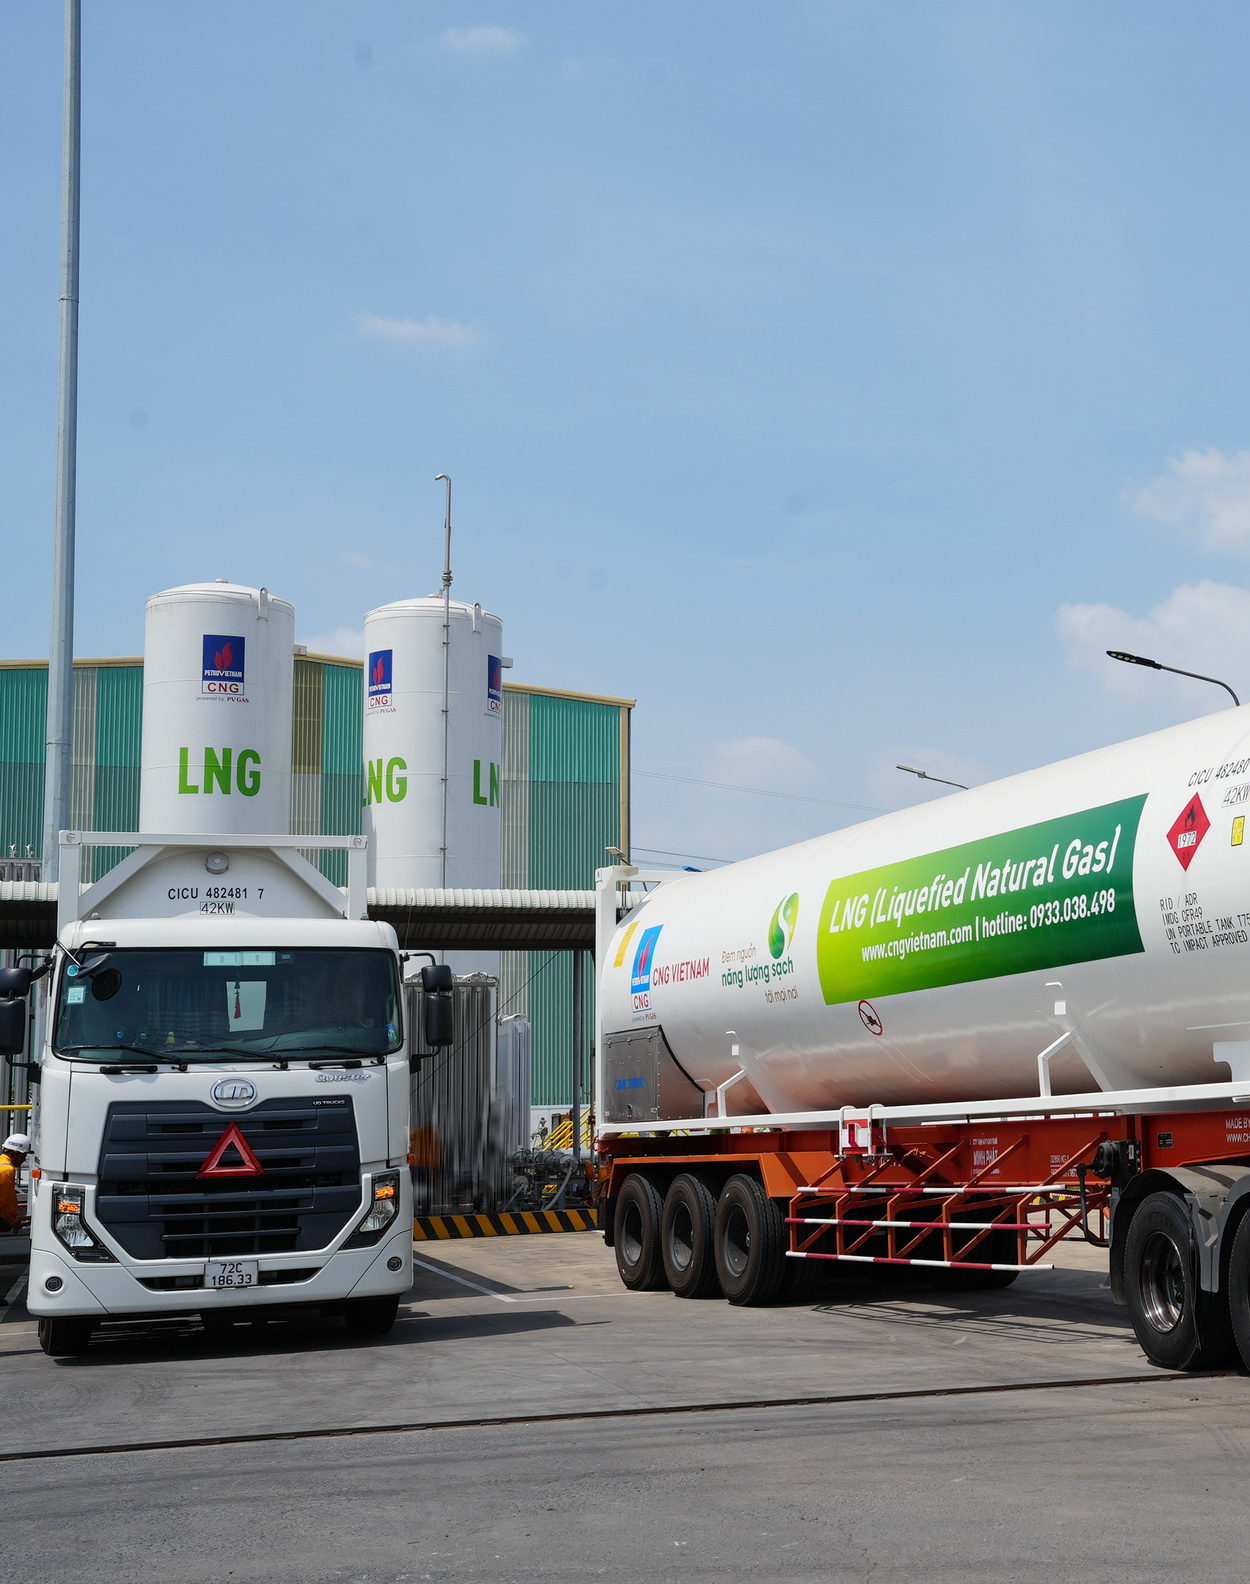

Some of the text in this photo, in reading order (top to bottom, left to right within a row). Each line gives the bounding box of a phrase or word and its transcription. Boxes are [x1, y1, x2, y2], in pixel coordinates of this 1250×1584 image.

[207, 682, 239, 693] CNG
[369, 695, 389, 707] CNG
[178, 747, 261, 797] LNG
[1188, 767, 1214, 787] CICU
[1215, 757, 1250, 780] 482480
[1224, 784, 1250, 805] 42KW
[1178, 832, 1196, 847] 1972
[829, 823, 1122, 934] LNG (Liquefied Natural Gas)
[168, 887, 264, 900] CICU 482481 7
[1160, 897, 1173, 911] RID
[1185, 892, 1198, 906] ADR
[201, 902, 234, 914] 42KW
[1162, 906, 1203, 926] IMDG CFR49
[861, 921, 972, 962] www.cngvietnam.com
[982, 914, 1028, 939] hotline:
[1030, 888, 1115, 928] 0933.038.498
[1165, 928, 1176, 940] UN
[1178, 920, 1213, 938] PORTABLE
[1215, 916, 1235, 931] TANK
[1170, 930, 1248, 954] TC IMPACT APPROVED
[722, 950, 736, 963] Đem
[653, 966, 669, 986] CNG
[672, 957, 709, 983] VIETNAM
[722, 956, 794, 988] năng lượng sạch
[633, 993, 648, 1010] CNG
[315, 1073, 373, 1083] Quester
[216, 1085, 253, 1100] UD
[1225, 1118, 1243, 1129] MADE
[1244, 1117, 1250, 1129] BY
[220, 1262, 243, 1274] 72C
[211, 1274, 252, 1286] 186.33
